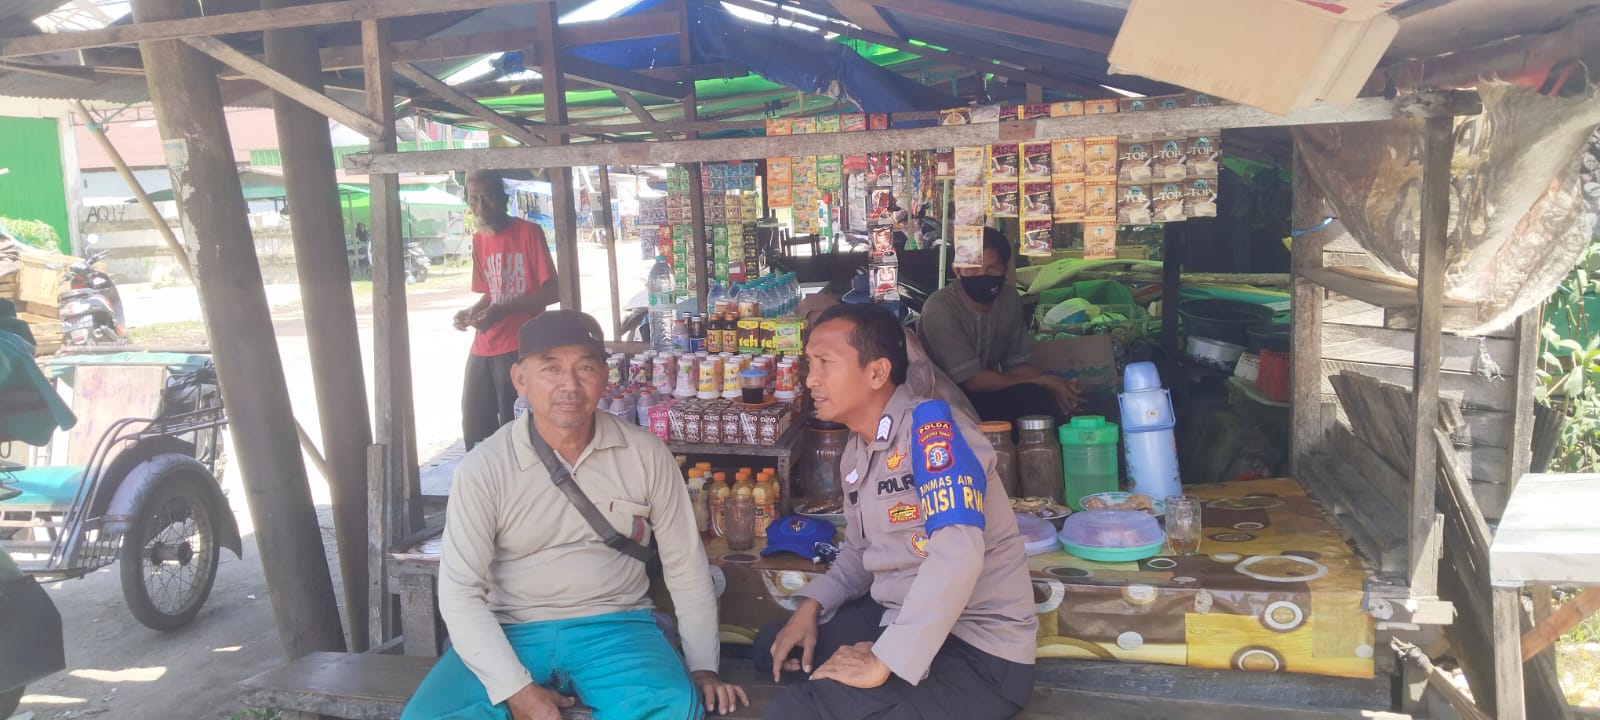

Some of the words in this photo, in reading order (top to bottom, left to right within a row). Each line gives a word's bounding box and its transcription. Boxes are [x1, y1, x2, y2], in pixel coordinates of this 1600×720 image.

[1025, 104, 1051, 115] ABC
[994, 144, 1018, 156] ABC
[1025, 142, 1051, 154] ABC
[1125, 152, 1148, 161] TOP
[1158, 149, 1183, 159] TOP
[993, 183, 1018, 194] ABC
[1025, 182, 1051, 193] ABC
[1190, 188, 1214, 197] TOP
[1158, 191, 1183, 201] TOP
[739, 335, 758, 348] teh
[919, 422, 949, 434] POLDA
[878, 474, 915, 495] POLR
[957, 474, 974, 487] AIR
[921, 487, 955, 519] OLISI
